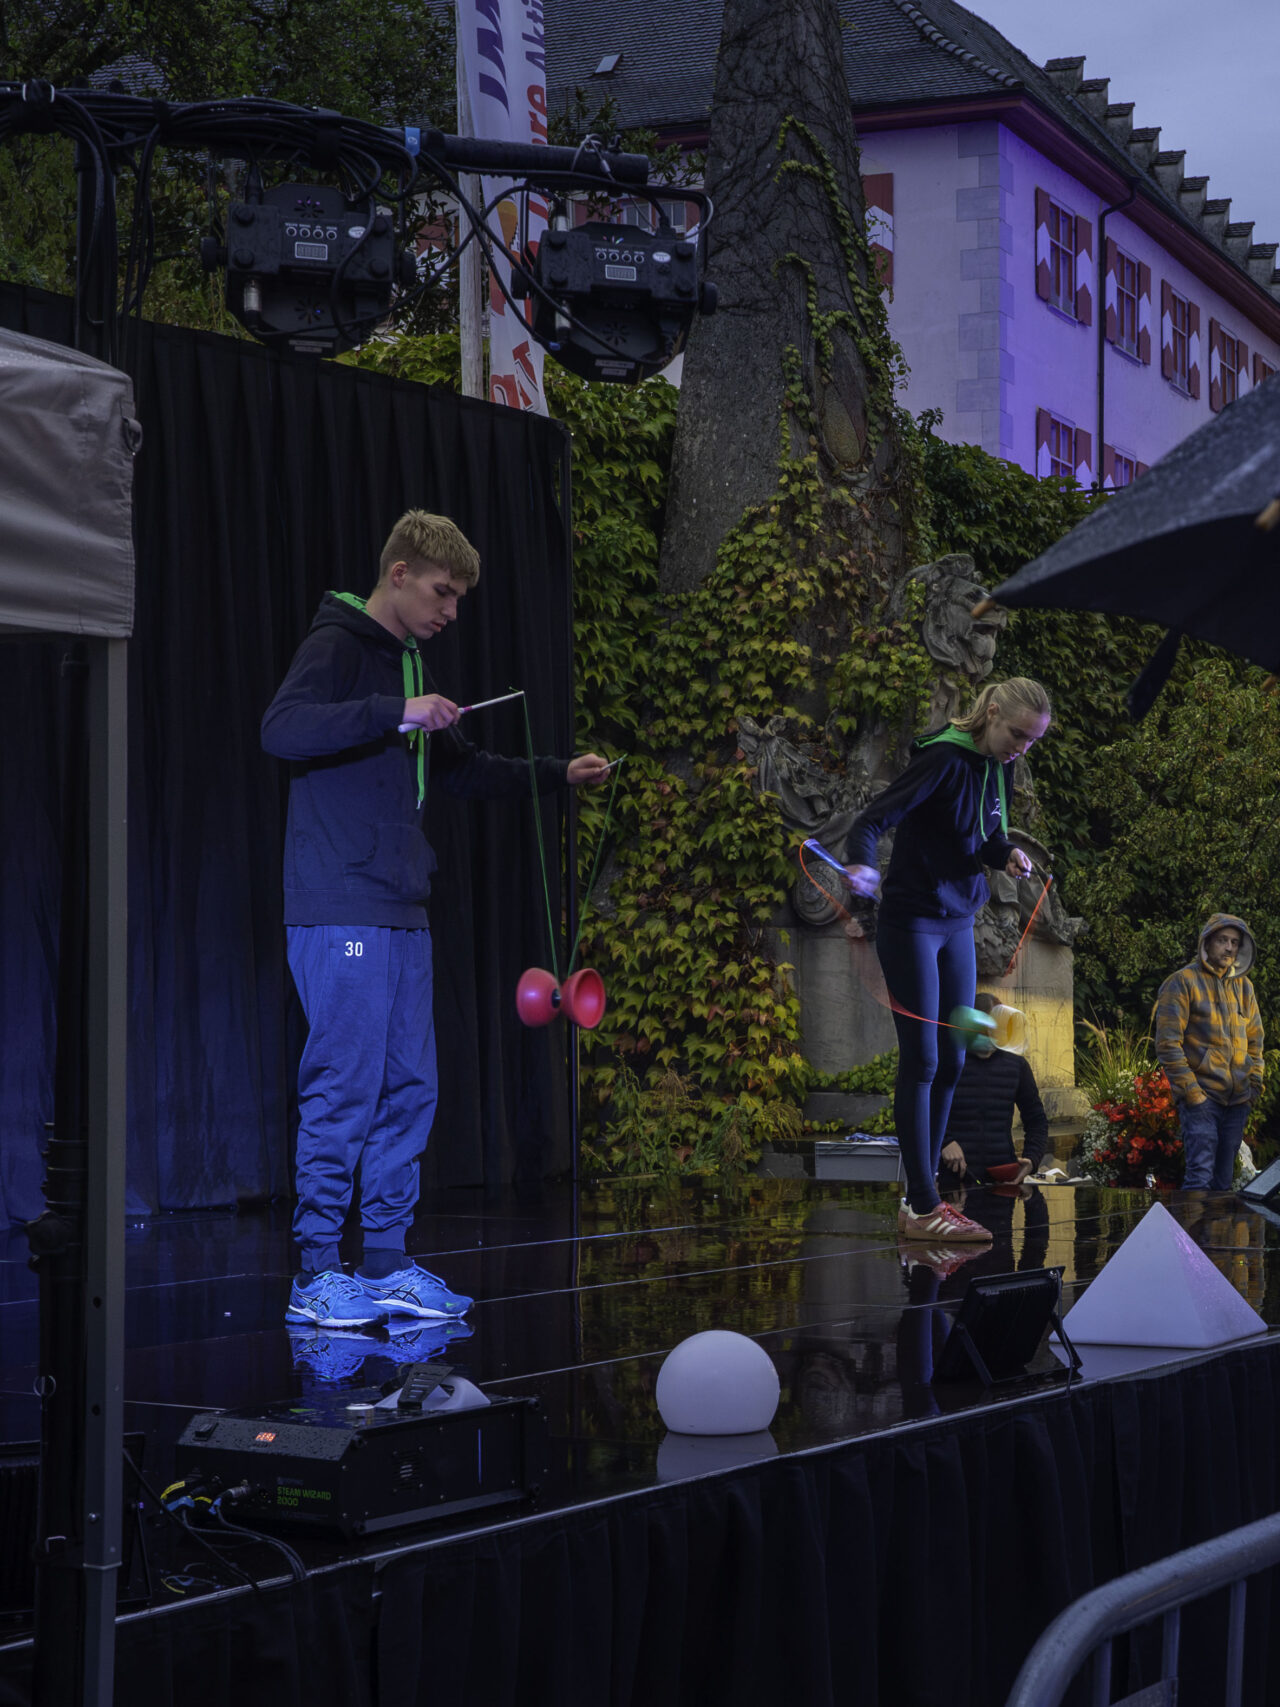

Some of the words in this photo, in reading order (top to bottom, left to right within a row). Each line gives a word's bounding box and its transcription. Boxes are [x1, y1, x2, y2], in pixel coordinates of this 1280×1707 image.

[345, 941, 363, 957] 30
[277, 1486, 301, 1497] STEAM
[302, 1489, 332, 1500] WIZARD
[277, 1496, 299, 1506] 2000
